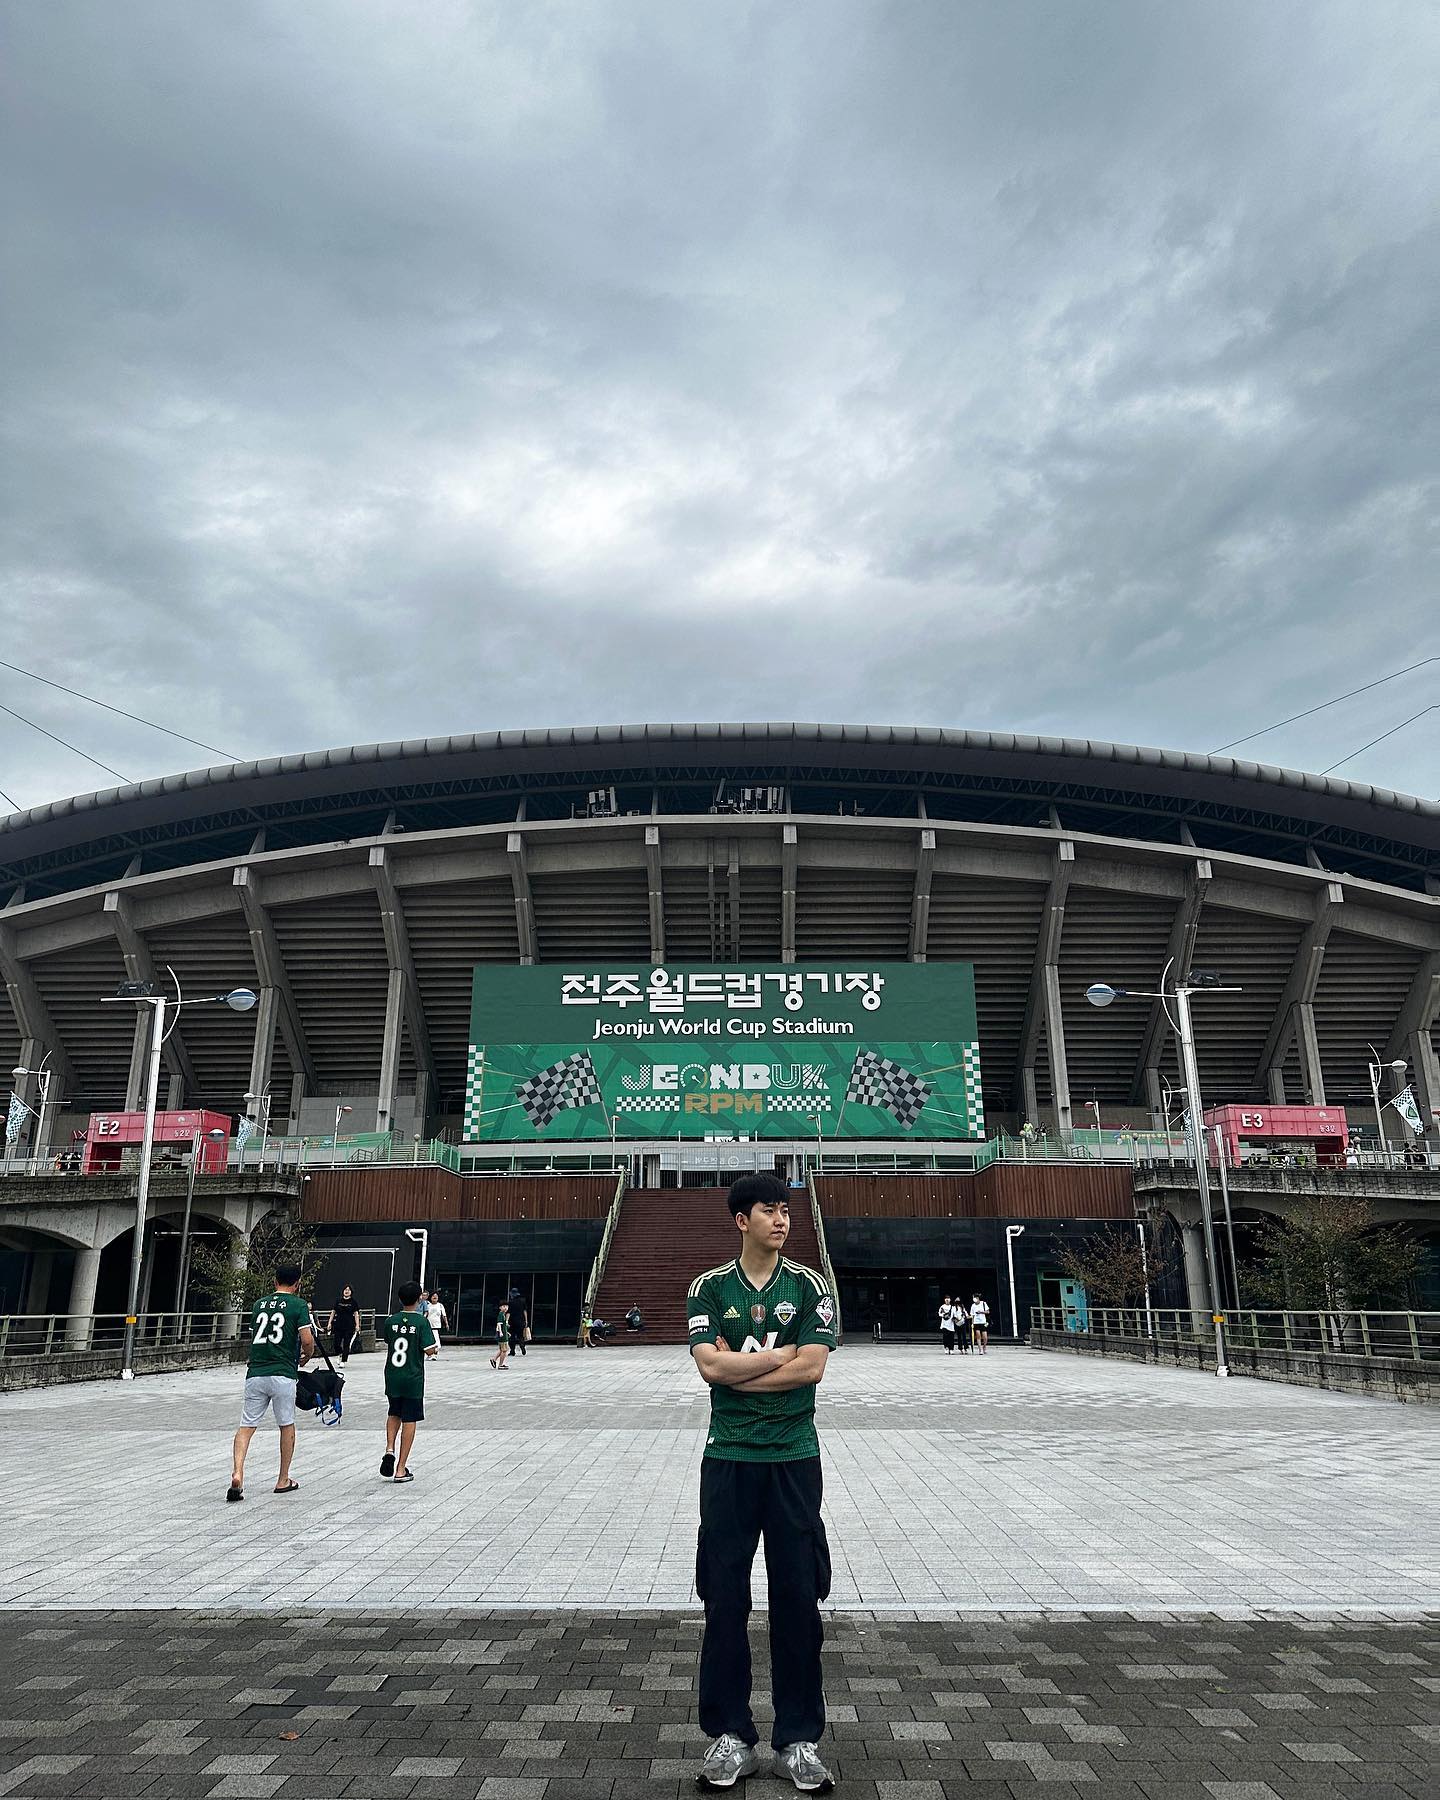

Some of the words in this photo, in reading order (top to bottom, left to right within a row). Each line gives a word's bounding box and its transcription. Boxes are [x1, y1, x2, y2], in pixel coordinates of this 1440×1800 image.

[560, 967, 885, 1013] 전주월드컵경기장
[593, 1018, 656, 1040] Jeonju
[658, 1017, 721, 1035] World
[726, 1018, 767, 1039] Cup
[772, 1016, 854, 1035] Stadium
[621, 1063, 830, 1091] JEONBUK
[684, 1093, 763, 1114] RPM
[98, 1120, 120, 1136] E2
[1241, 1113, 1264, 1128] E3
[252, 1311, 286, 1345] 23
[391, 1336, 409, 1368] 8
